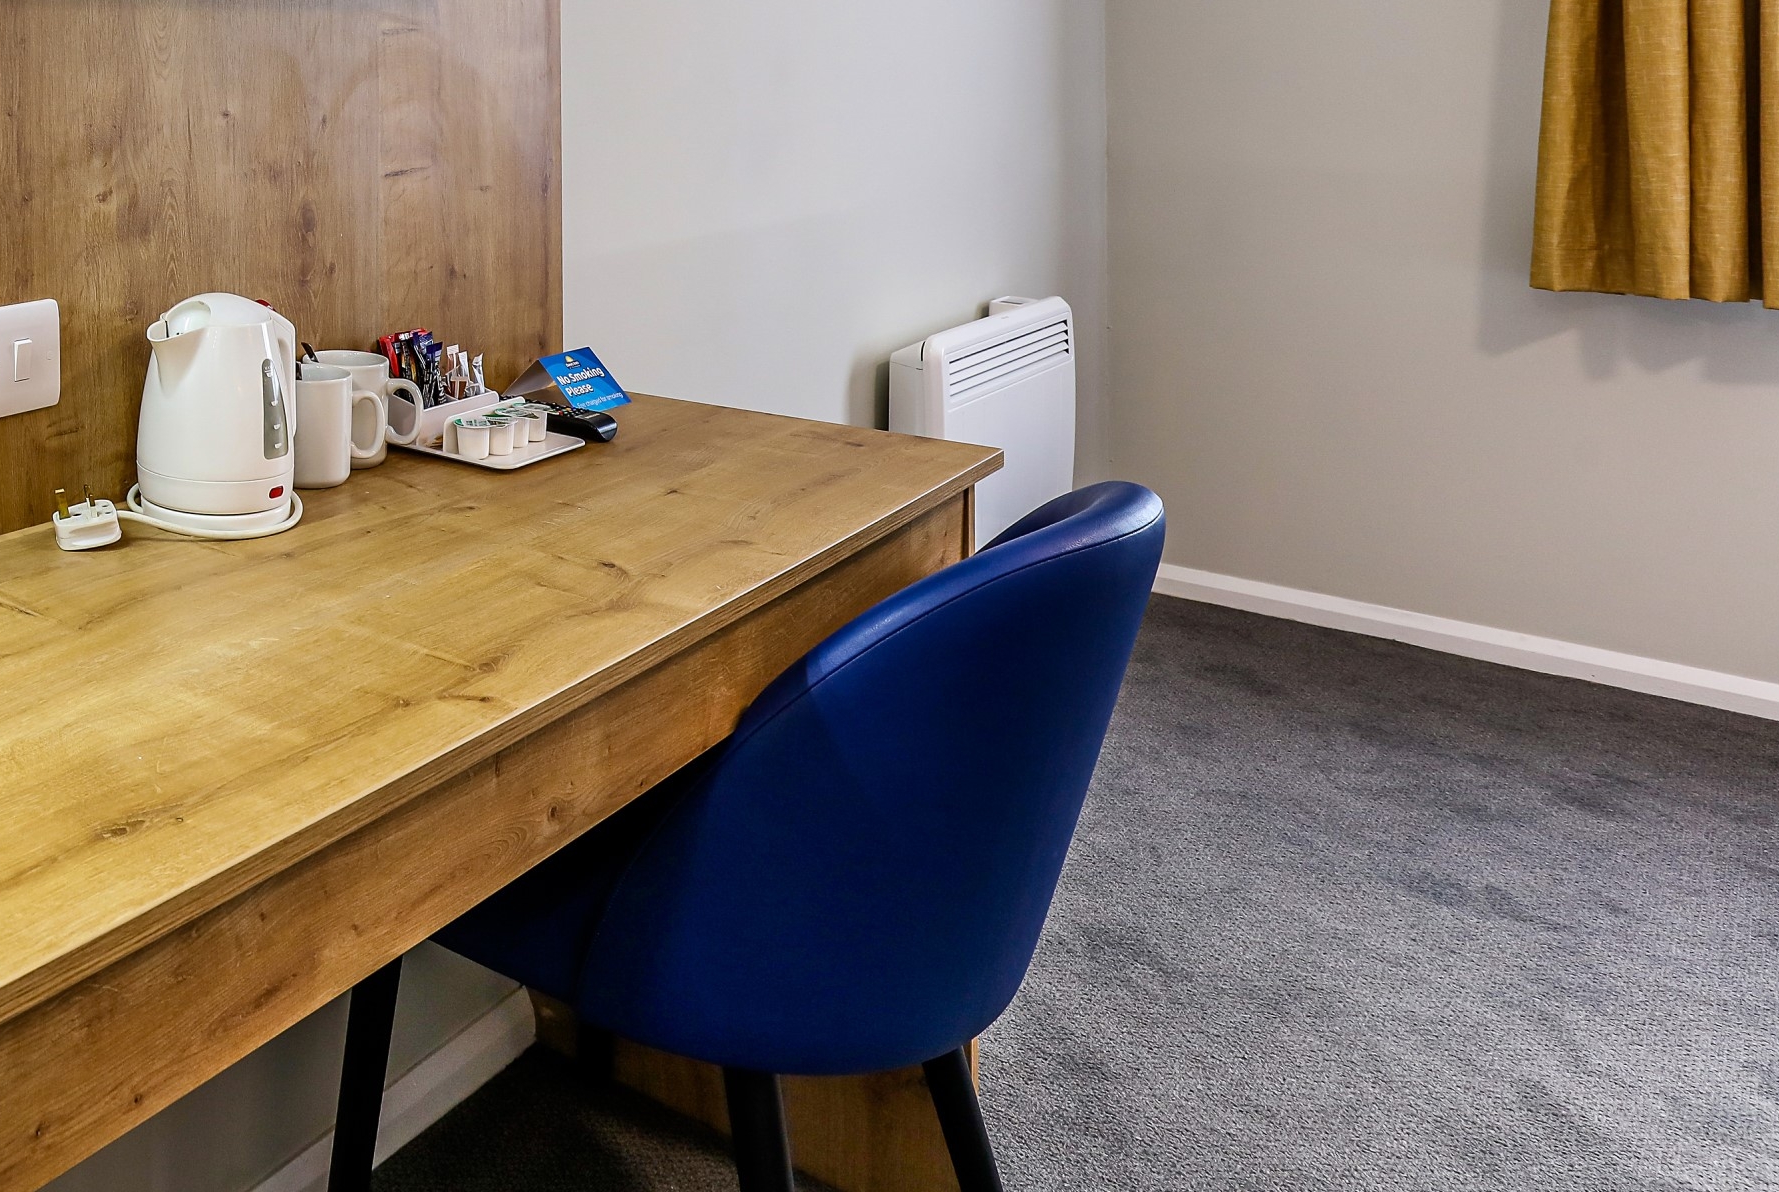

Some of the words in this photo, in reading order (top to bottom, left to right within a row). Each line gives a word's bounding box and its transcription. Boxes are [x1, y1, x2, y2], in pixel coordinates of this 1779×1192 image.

[557, 375, 571, 386] No
[569, 367, 605, 383] Smoking
[565, 383, 594, 397] Please
